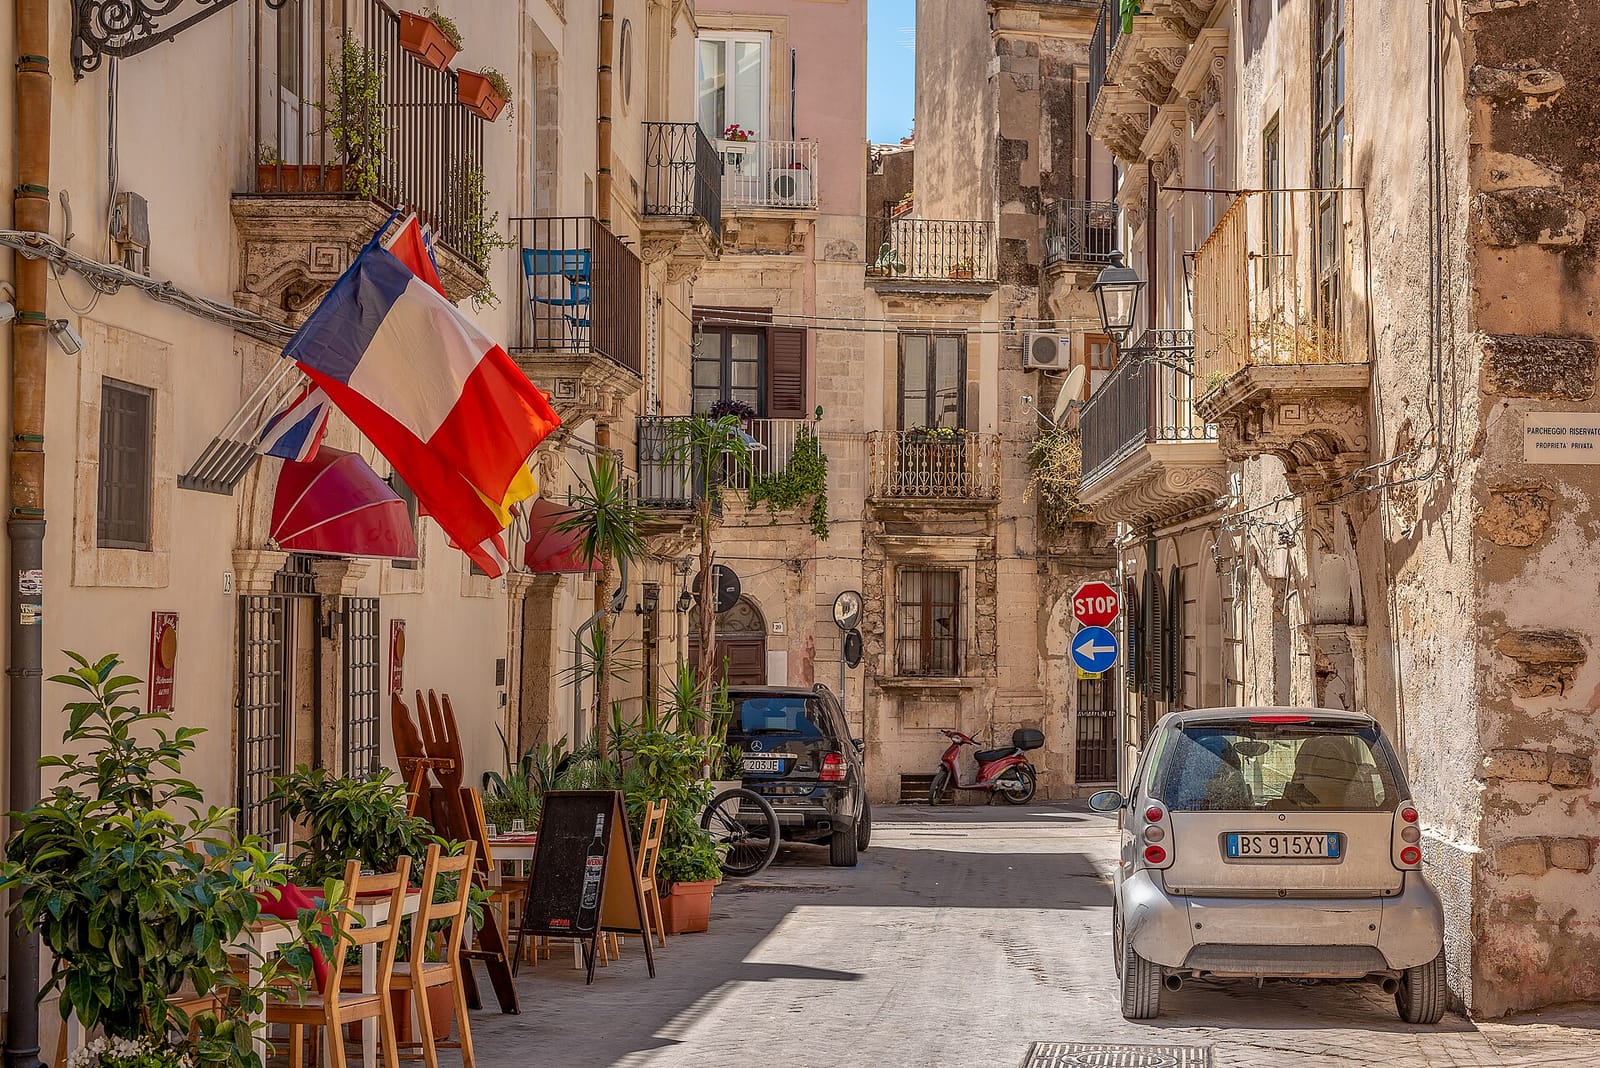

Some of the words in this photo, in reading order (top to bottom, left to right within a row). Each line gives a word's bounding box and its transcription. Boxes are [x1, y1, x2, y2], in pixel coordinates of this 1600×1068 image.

[1075, 595, 1116, 615] STOP
[750, 760, 778, 770] 203JE
[1240, 836, 1262, 854] BS
[1269, 836, 1325, 854] 915XY
